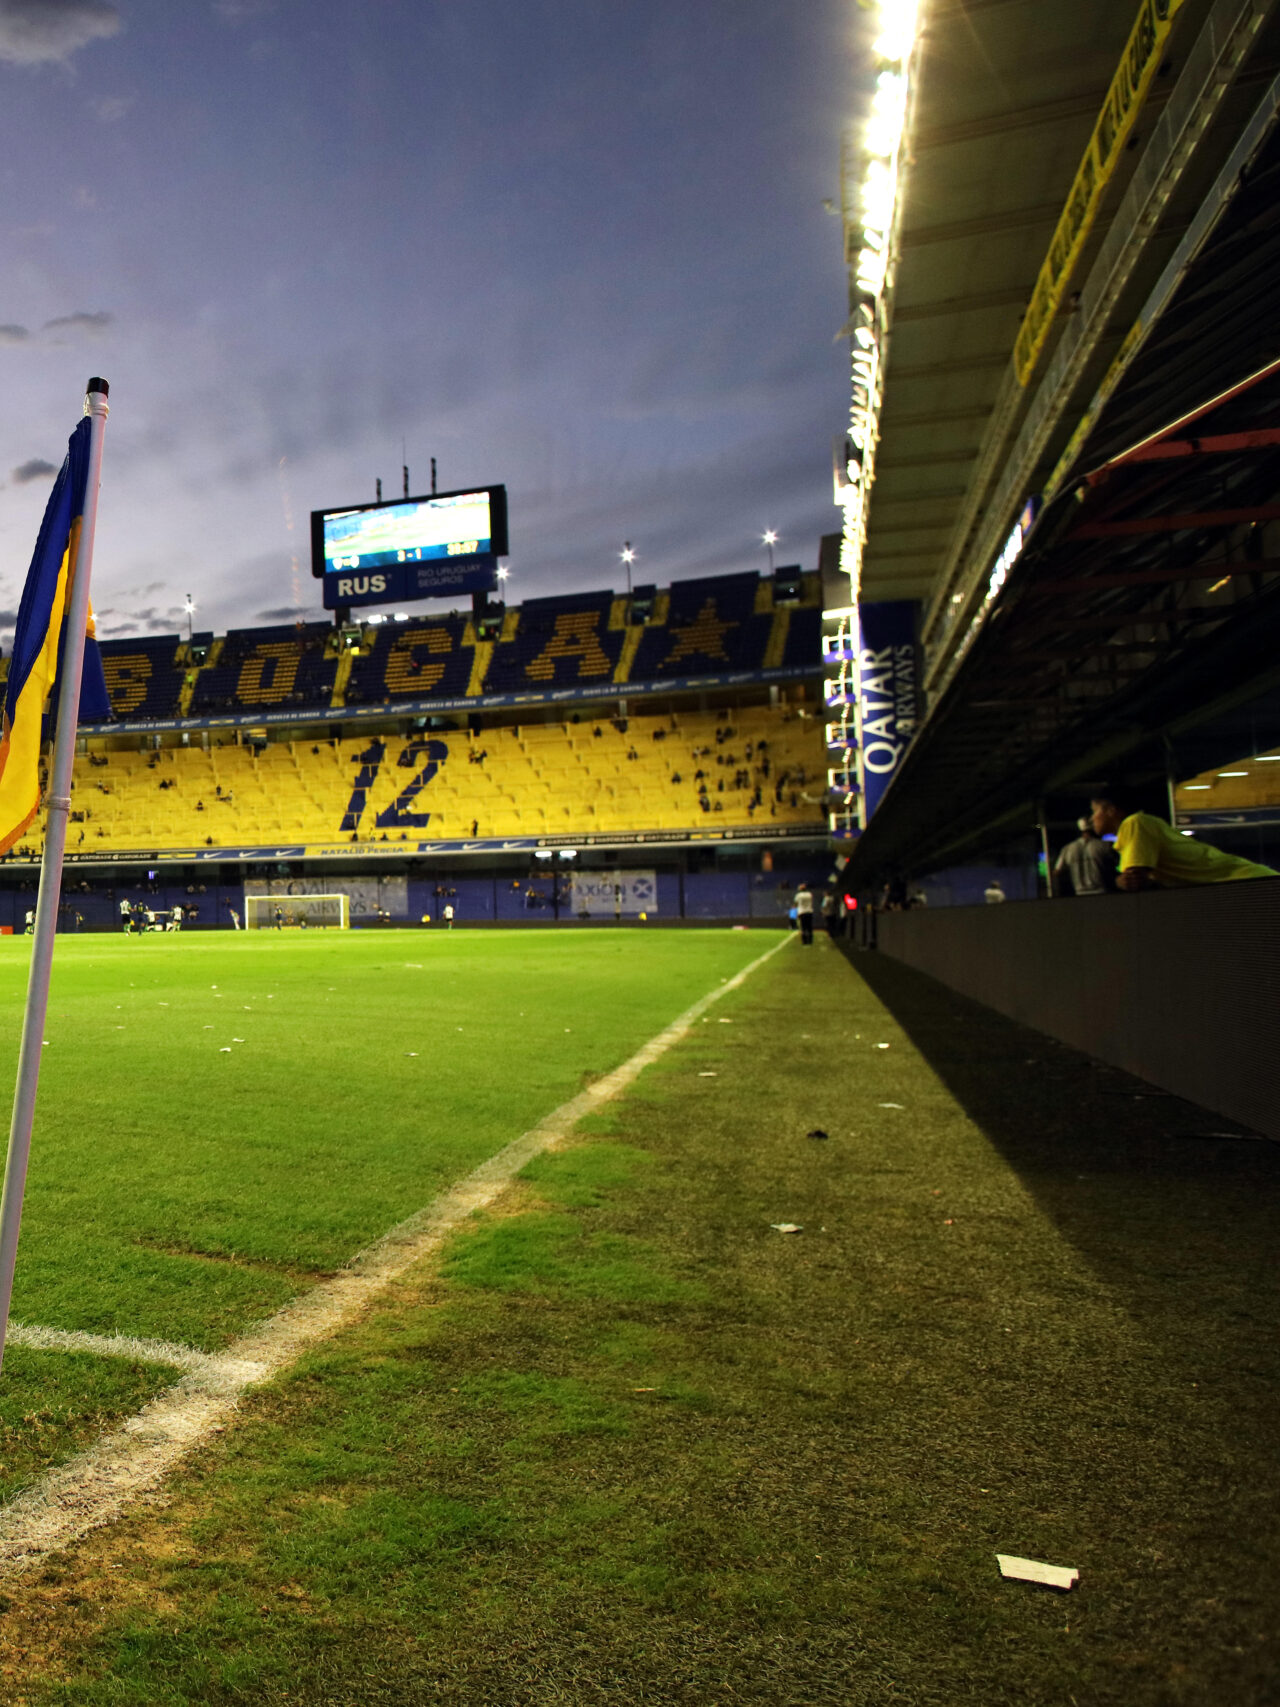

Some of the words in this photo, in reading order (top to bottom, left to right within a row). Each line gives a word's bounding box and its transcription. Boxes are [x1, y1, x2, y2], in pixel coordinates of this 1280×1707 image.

[338, 574, 387, 597] RUS
[418, 575, 465, 588] SEGUROS
[437, 563, 482, 577] URUGUAY
[860, 645, 904, 775] QATAR
[895, 643, 917, 739] AIRWAYS
[339, 738, 449, 833] 12
